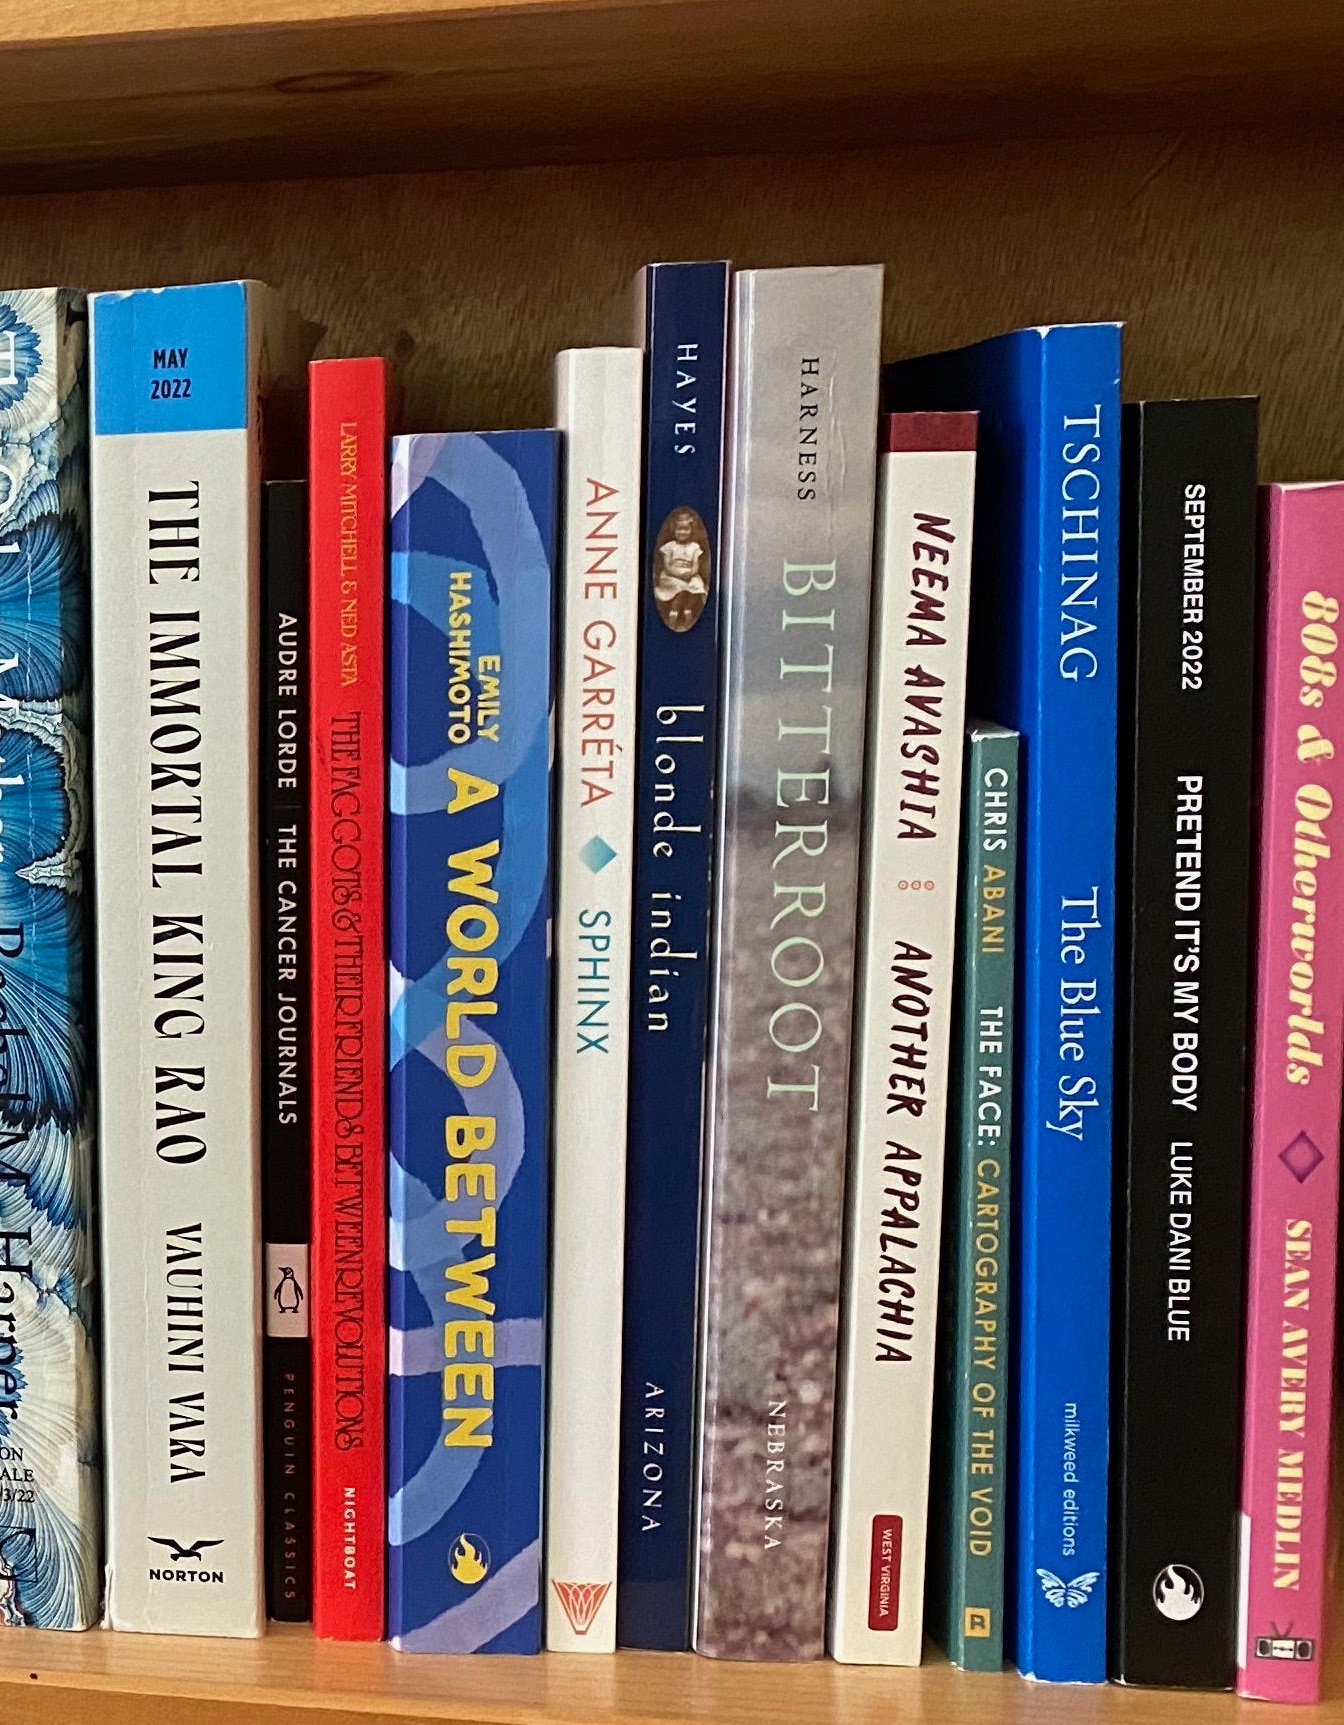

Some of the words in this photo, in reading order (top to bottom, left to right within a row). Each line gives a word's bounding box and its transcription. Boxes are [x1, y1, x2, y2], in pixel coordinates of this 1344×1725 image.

[151, 379, 192, 399] 2022
[152, 348, 188, 369] MAY
[673, 343, 698, 456] HAYES
[797, 357, 820, 501] HARNESS
[583, 477, 619, 601] ANNE
[905, 512, 956, 647] NEEMA
[1059, 404, 1102, 683] TSCHINAG
[1181, 483, 1206, 627] SEPTEMBER
[277, 612, 300, 696] AUDRE
[447, 572, 472, 745] HASHIMOTO
[475, 655, 501, 743] EMILY
[1180, 630, 1203, 690] 2022
[277, 708, 299, 789] LORDE
[580, 619, 621, 807] GARRÉTA
[897, 665, 943, 841] AVASHIA
[446, 767, 501, 815] A
[767, 559, 837, 1112] BITTERROOT
[982, 769, 1007, 851] CHRIS
[981, 865, 1005, 953] ABANI
[445, 841, 500, 1088] WORLD
[575, 910, 611, 1055] SPHINX
[1169, 1142, 1193, 1205] LUKE
[442, 1116, 497, 1449] BETWEEN
[1167, 1215, 1192, 1270] DANI
[1283, 1217, 1312, 1318] SEAN
[166, 1222, 205, 1374] VAUHINI
[1166, 1278, 1191, 1342] BLUE
[1279, 1319, 1311, 1437] AVERY
[0, 1446, 23, 1462] ON
[168, 1393, 205, 1484] VARA
[642, 1381, 664, 1532] ARIZONA
[763, 1401, 785, 1551] NEBRASKA
[1062, 1403, 1078, 1485] milkweed
[342, 1487, 357, 1590] NIGHTBOAT
[880, 1527, 893, 1564] WEST
[1062, 1490, 1077, 1556] editions
[1272, 1447, 1305, 1591] MEDLIN
[148, 1568, 223, 1584] NORTON
[877, 1564, 892, 1617] VIRGINIA
